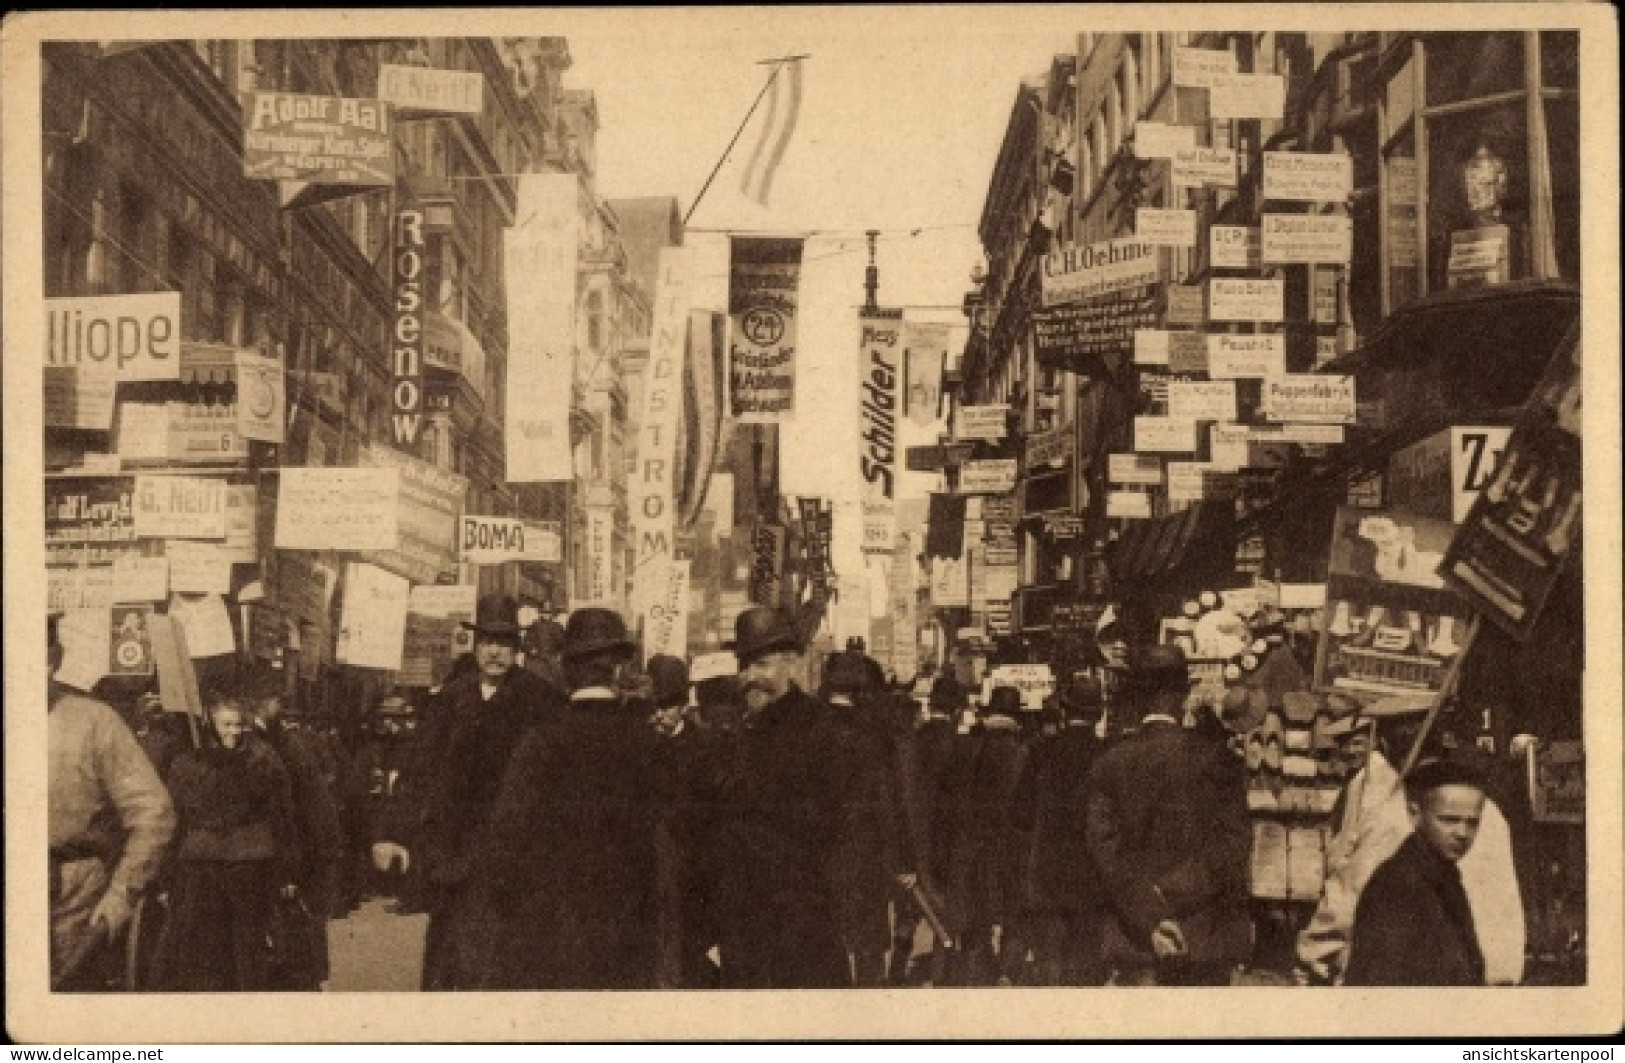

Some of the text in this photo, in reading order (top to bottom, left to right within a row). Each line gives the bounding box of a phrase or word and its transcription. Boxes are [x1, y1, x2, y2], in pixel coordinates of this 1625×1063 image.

[250, 93, 389, 136] Adolf Aal
[392, 208, 424, 445] Rosenow
[860, 351, 896, 500] Schilder
[463, 519, 525, 553] BOMA
